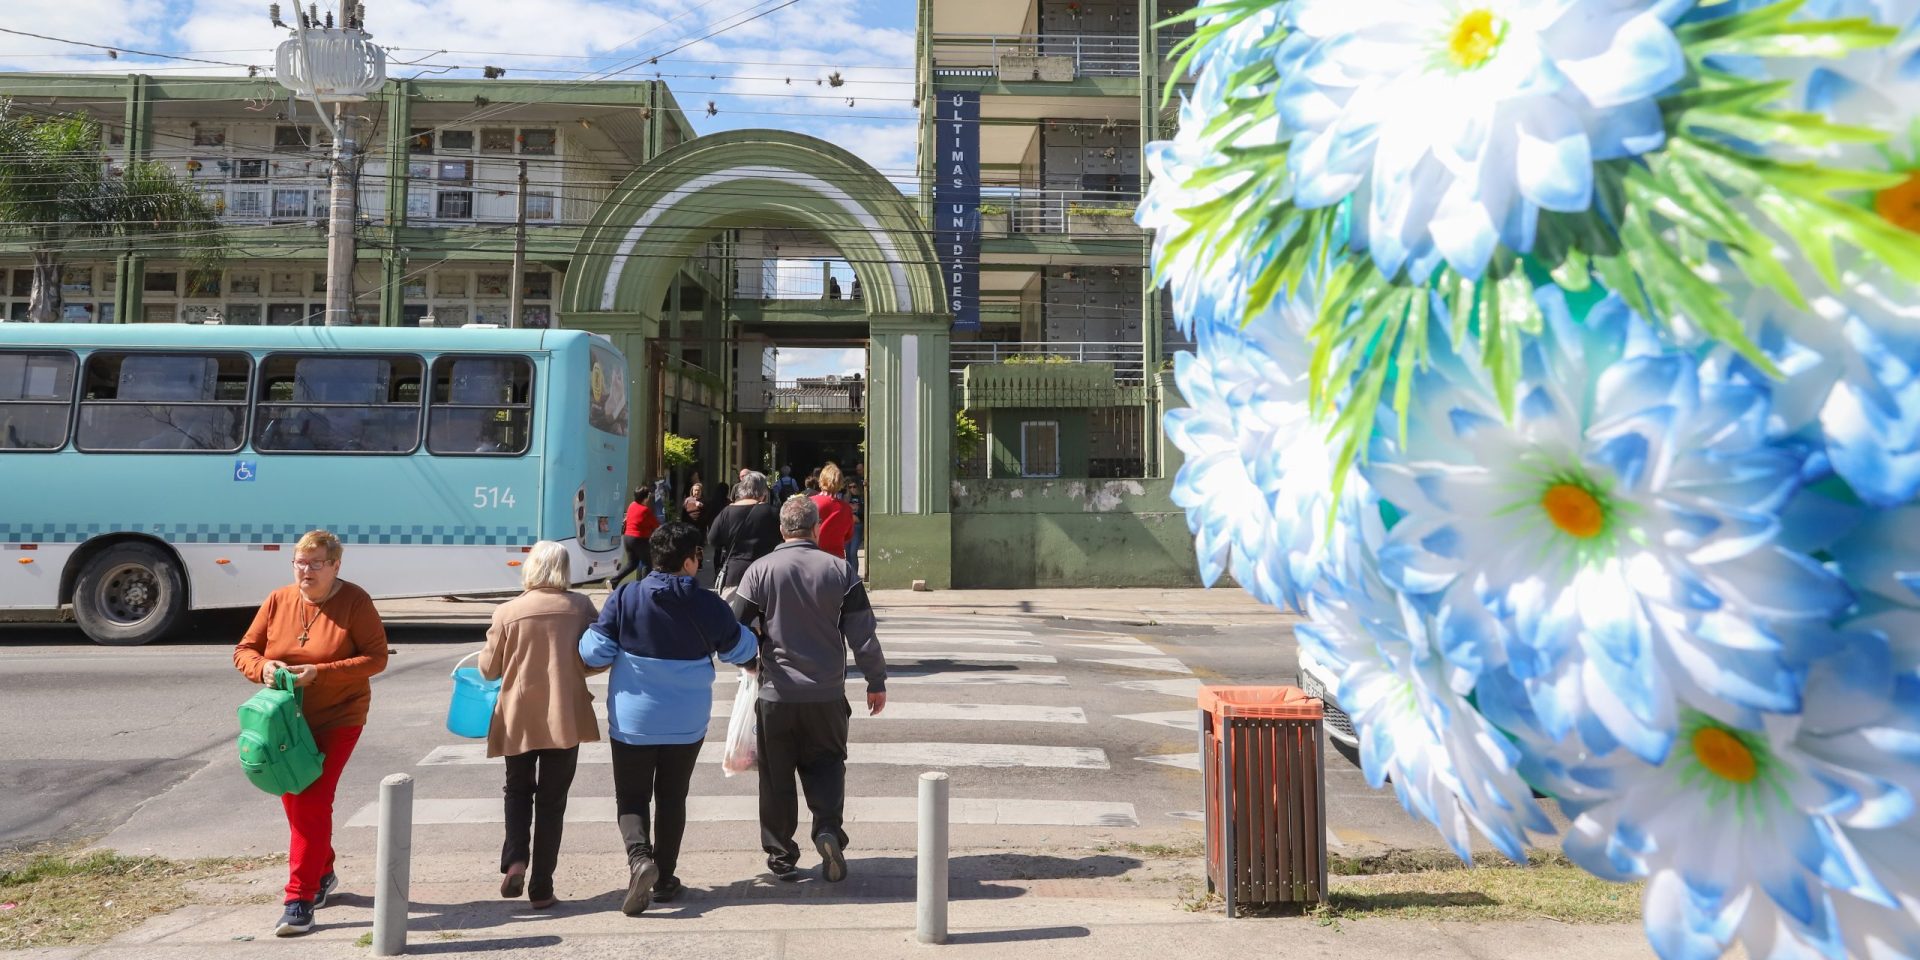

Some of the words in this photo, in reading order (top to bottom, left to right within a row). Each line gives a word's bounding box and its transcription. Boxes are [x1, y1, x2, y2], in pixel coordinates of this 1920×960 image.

[951, 93, 964, 189] ÚLTIMAS
[952, 204, 964, 312] UNIDADES
[473, 486, 516, 509] 514
